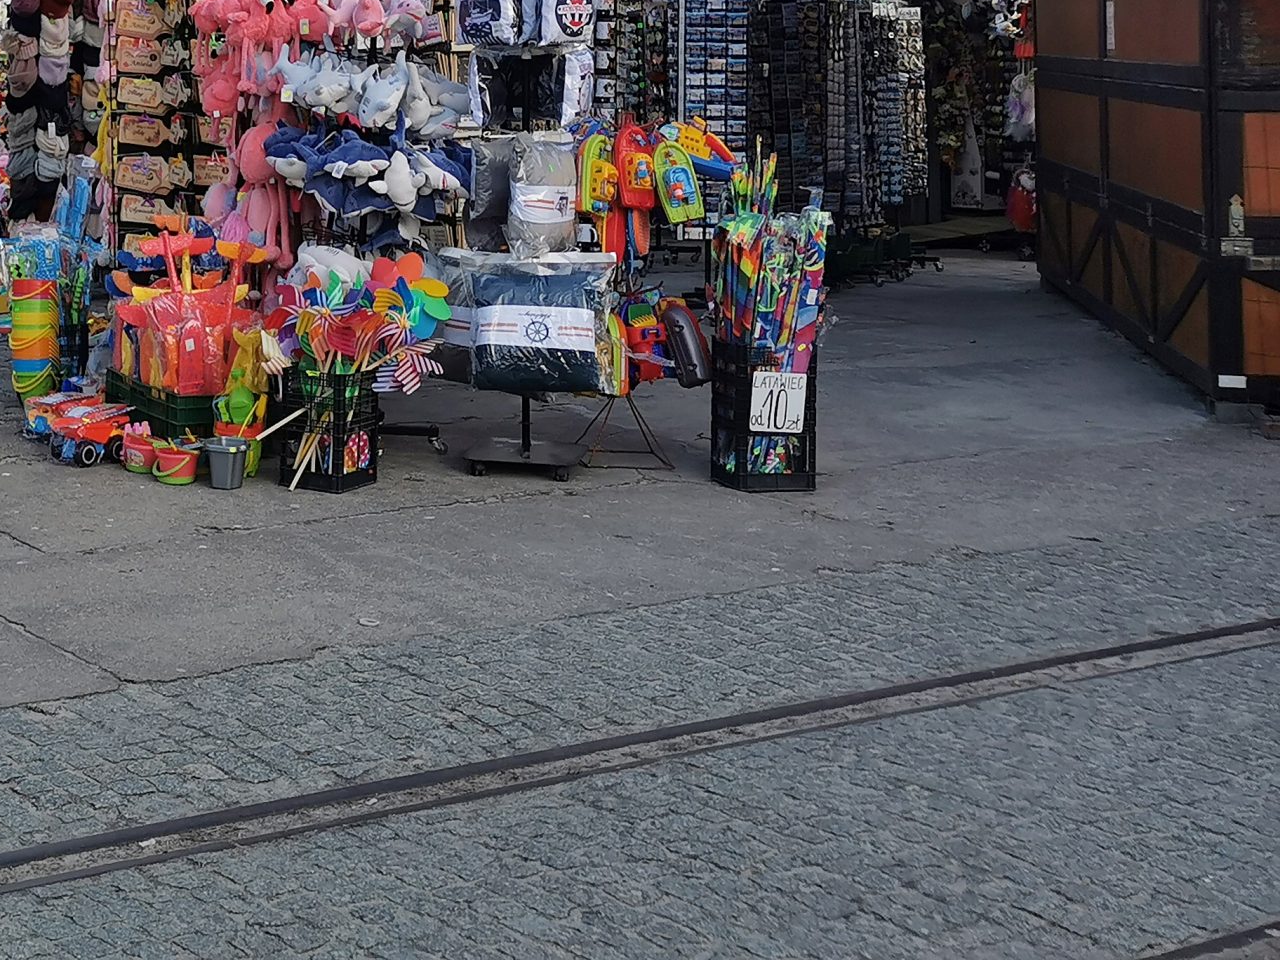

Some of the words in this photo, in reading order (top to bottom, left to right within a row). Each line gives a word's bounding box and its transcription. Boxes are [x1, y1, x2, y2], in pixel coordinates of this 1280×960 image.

[753, 375, 804, 390] LATAWIEC
[750, 408, 764, 426] od
[762, 388, 788, 430] 10
[786, 414, 802, 430] zł
